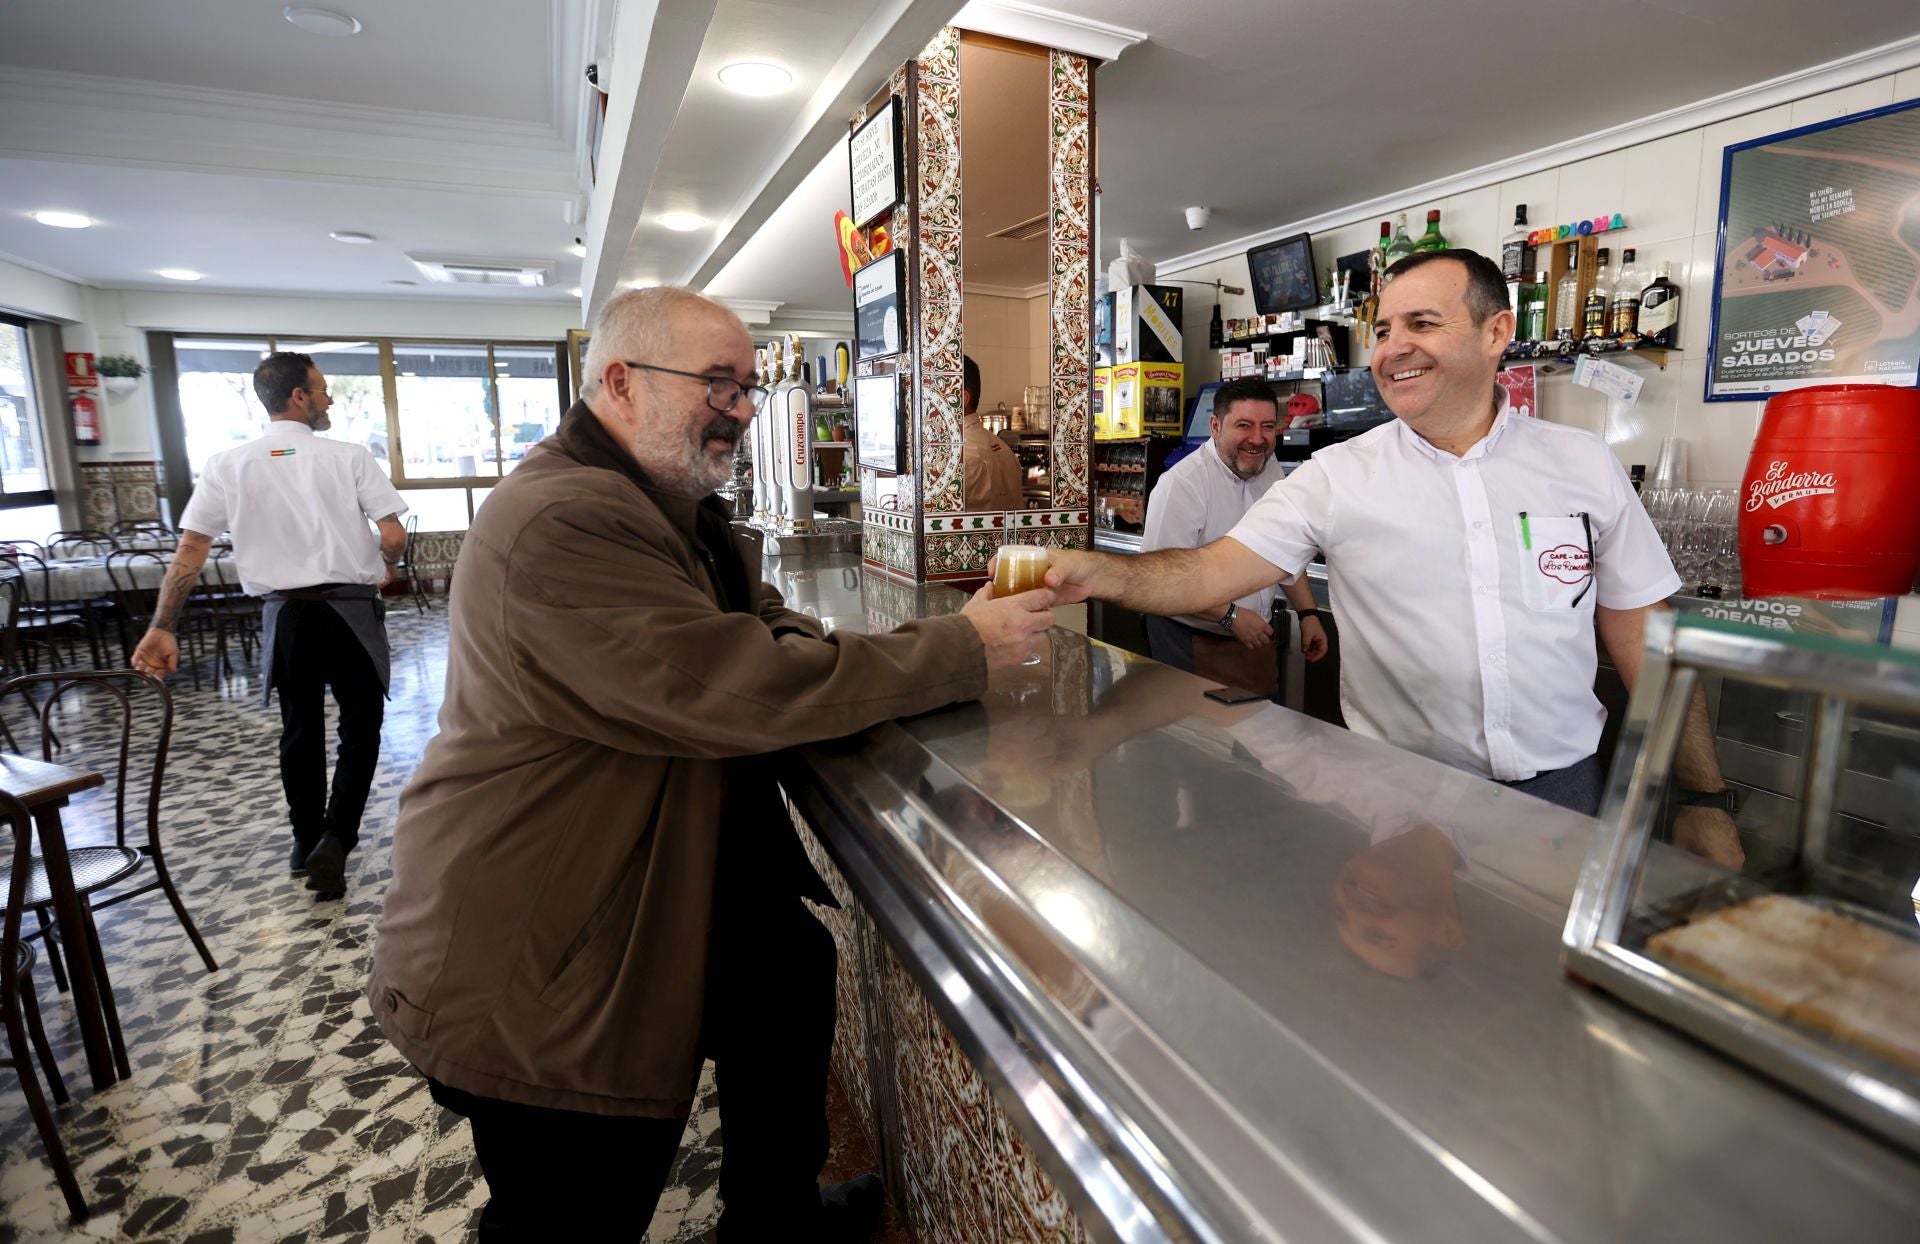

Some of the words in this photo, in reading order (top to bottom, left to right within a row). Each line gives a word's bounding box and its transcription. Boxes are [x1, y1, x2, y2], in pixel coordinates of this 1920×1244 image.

[1528, 213, 1625, 245] CHIPIONA
[1163, 291, 1179, 307] 47
[1143, 303, 1178, 349] MORILES
[1724, 329, 1777, 340] SORTEOS
[1780, 327, 1797, 336] DE
[1731, 335, 1822, 353] JUEVES
[1828, 339, 1837, 347] Y
[1722, 349, 1836, 368] SÁBADOS
[795, 413, 805, 465] Cruzcampo
[1766, 460, 1788, 481] El
[1745, 470, 1838, 512] Bandarra
[1773, 488, 1819, 504] VERMUT
